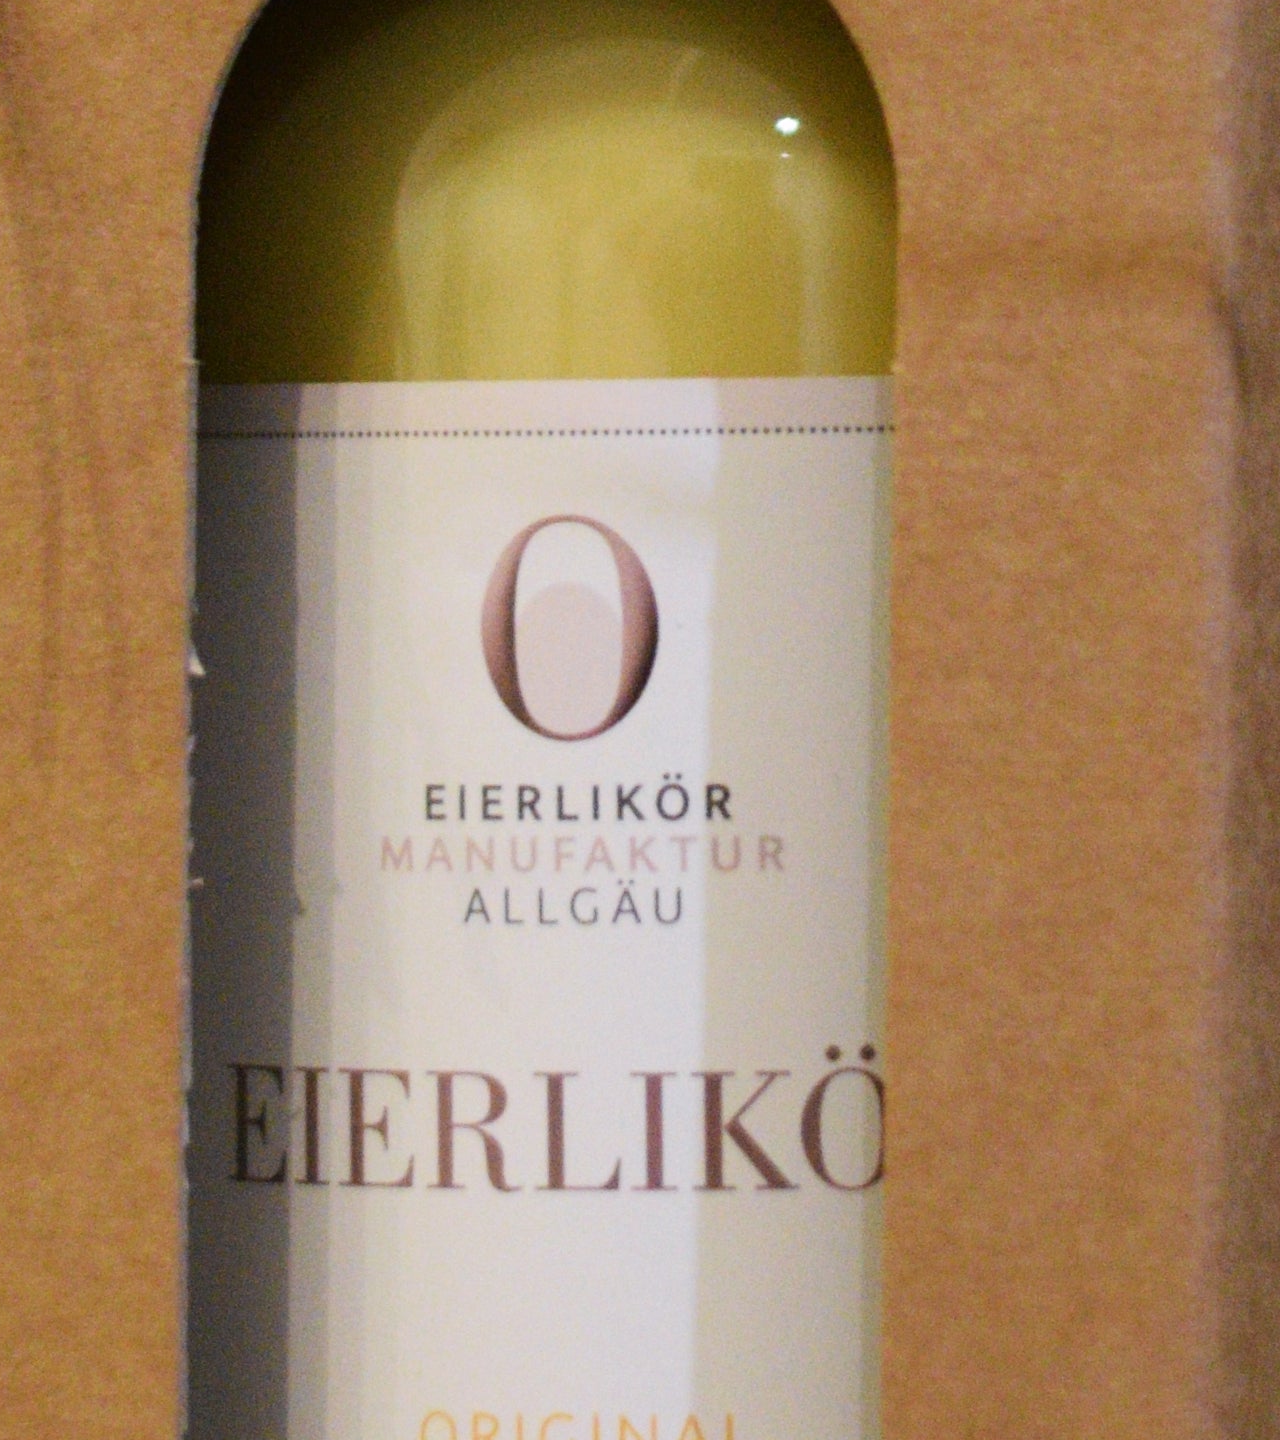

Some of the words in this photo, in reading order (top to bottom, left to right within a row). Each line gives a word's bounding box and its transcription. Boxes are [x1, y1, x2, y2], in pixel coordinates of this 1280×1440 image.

[424, 772, 733, 821] EIERLIKÖR
[380, 834, 786, 873] MANUFAKTUR
[463, 878, 683, 925] ALLGÄU
[226, 1044, 886, 1193] EIERLIKÖ
